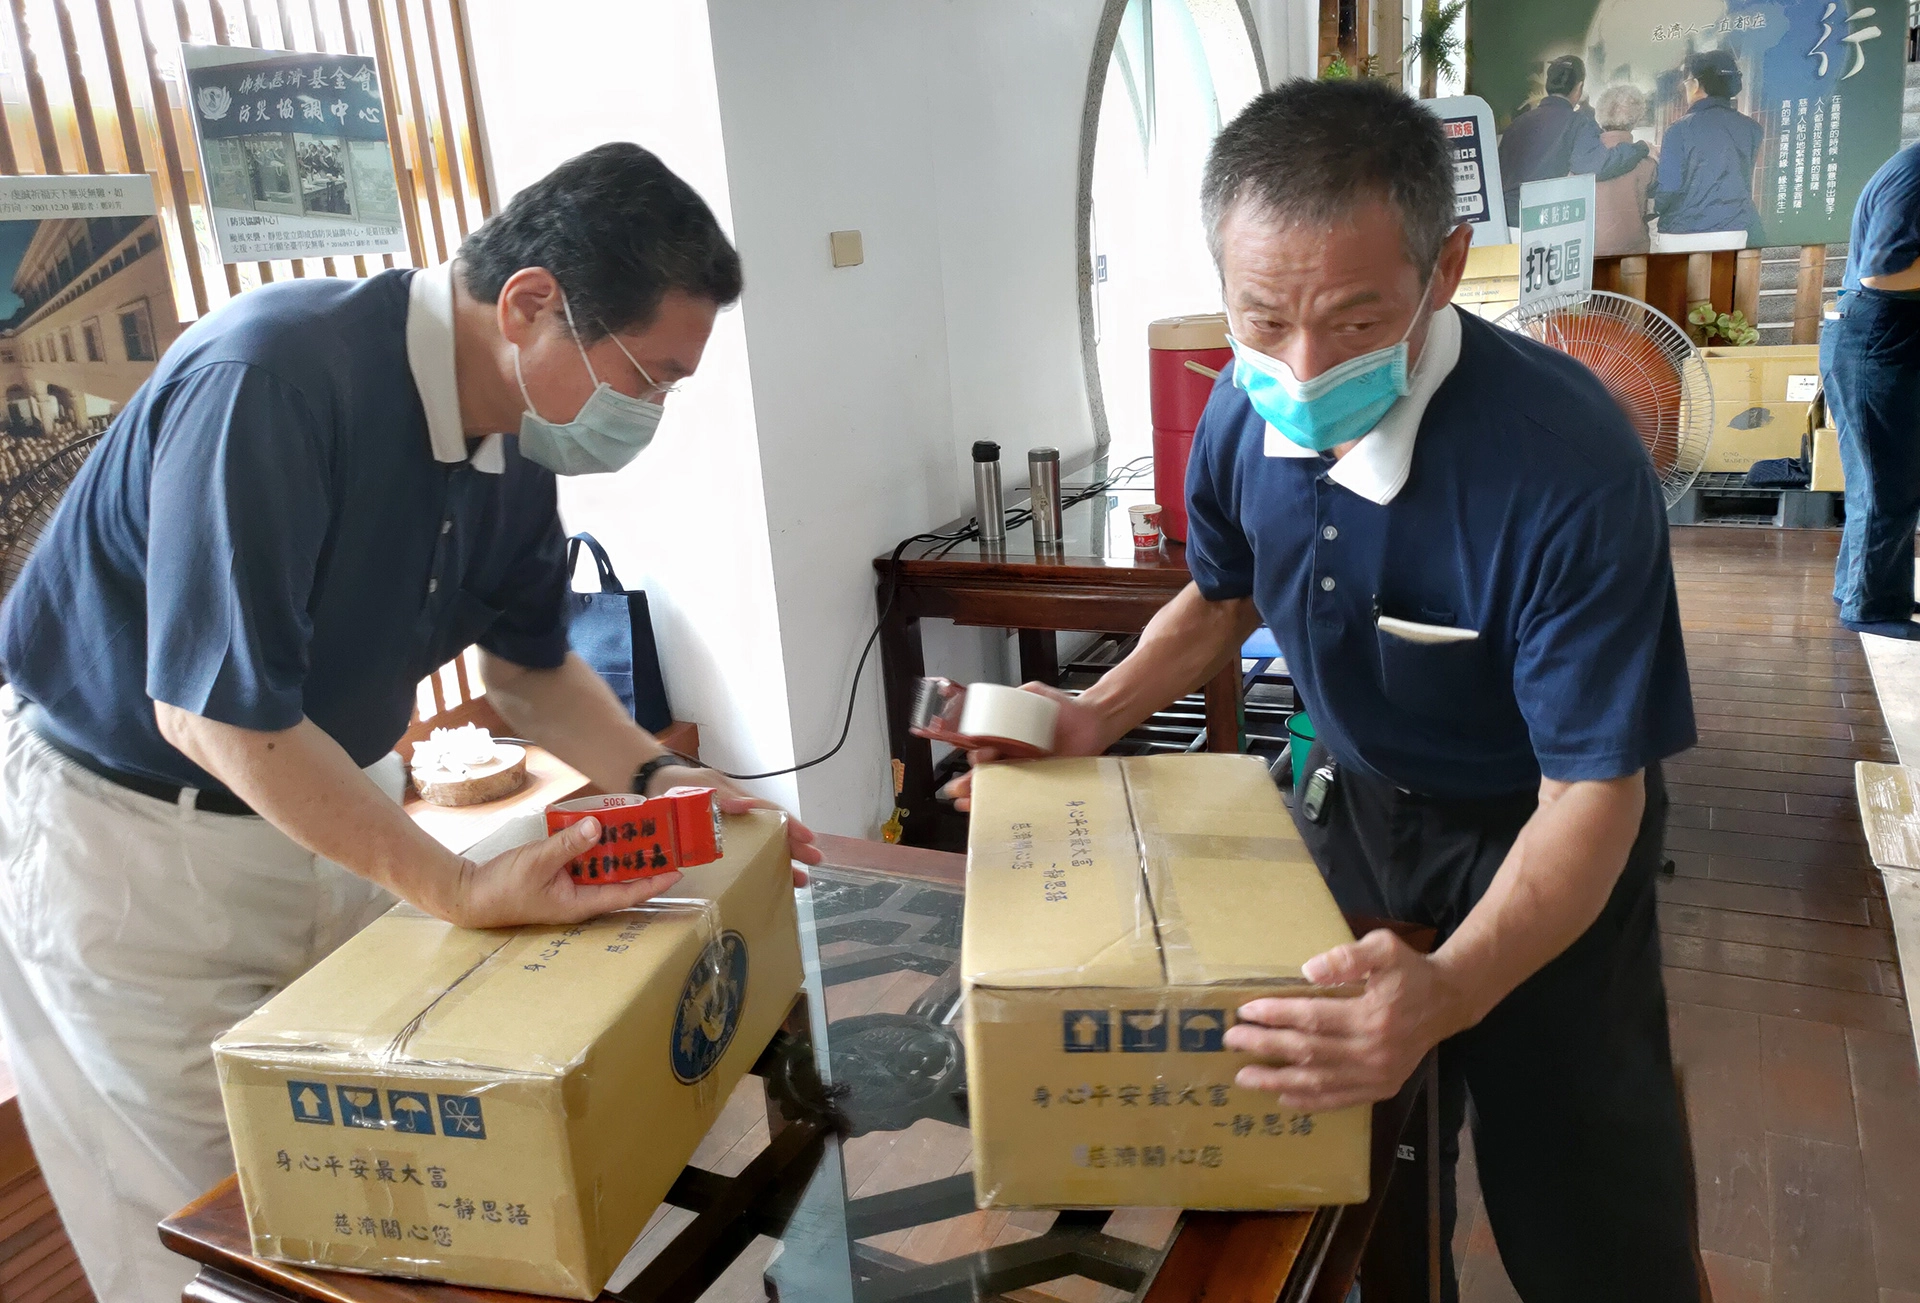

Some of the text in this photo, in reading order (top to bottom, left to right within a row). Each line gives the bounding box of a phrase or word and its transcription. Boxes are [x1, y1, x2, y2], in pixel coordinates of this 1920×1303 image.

[1652, 13, 1767, 42] 慈濟人一直都在
[1807, 2, 1882, 81] 行
[238, 63, 377, 95] 佛教慈濟基金會
[239, 98, 380, 125] 防災協調中心
[1525, 238, 1581, 293] 打包區
[603, 797, 626, 806] 3305
[1031, 1083, 1232, 1109] 身心平安最大富
[276, 1150, 448, 1190] 身心平安最大富
[334, 1213, 453, 1247] 慈濟關心您
